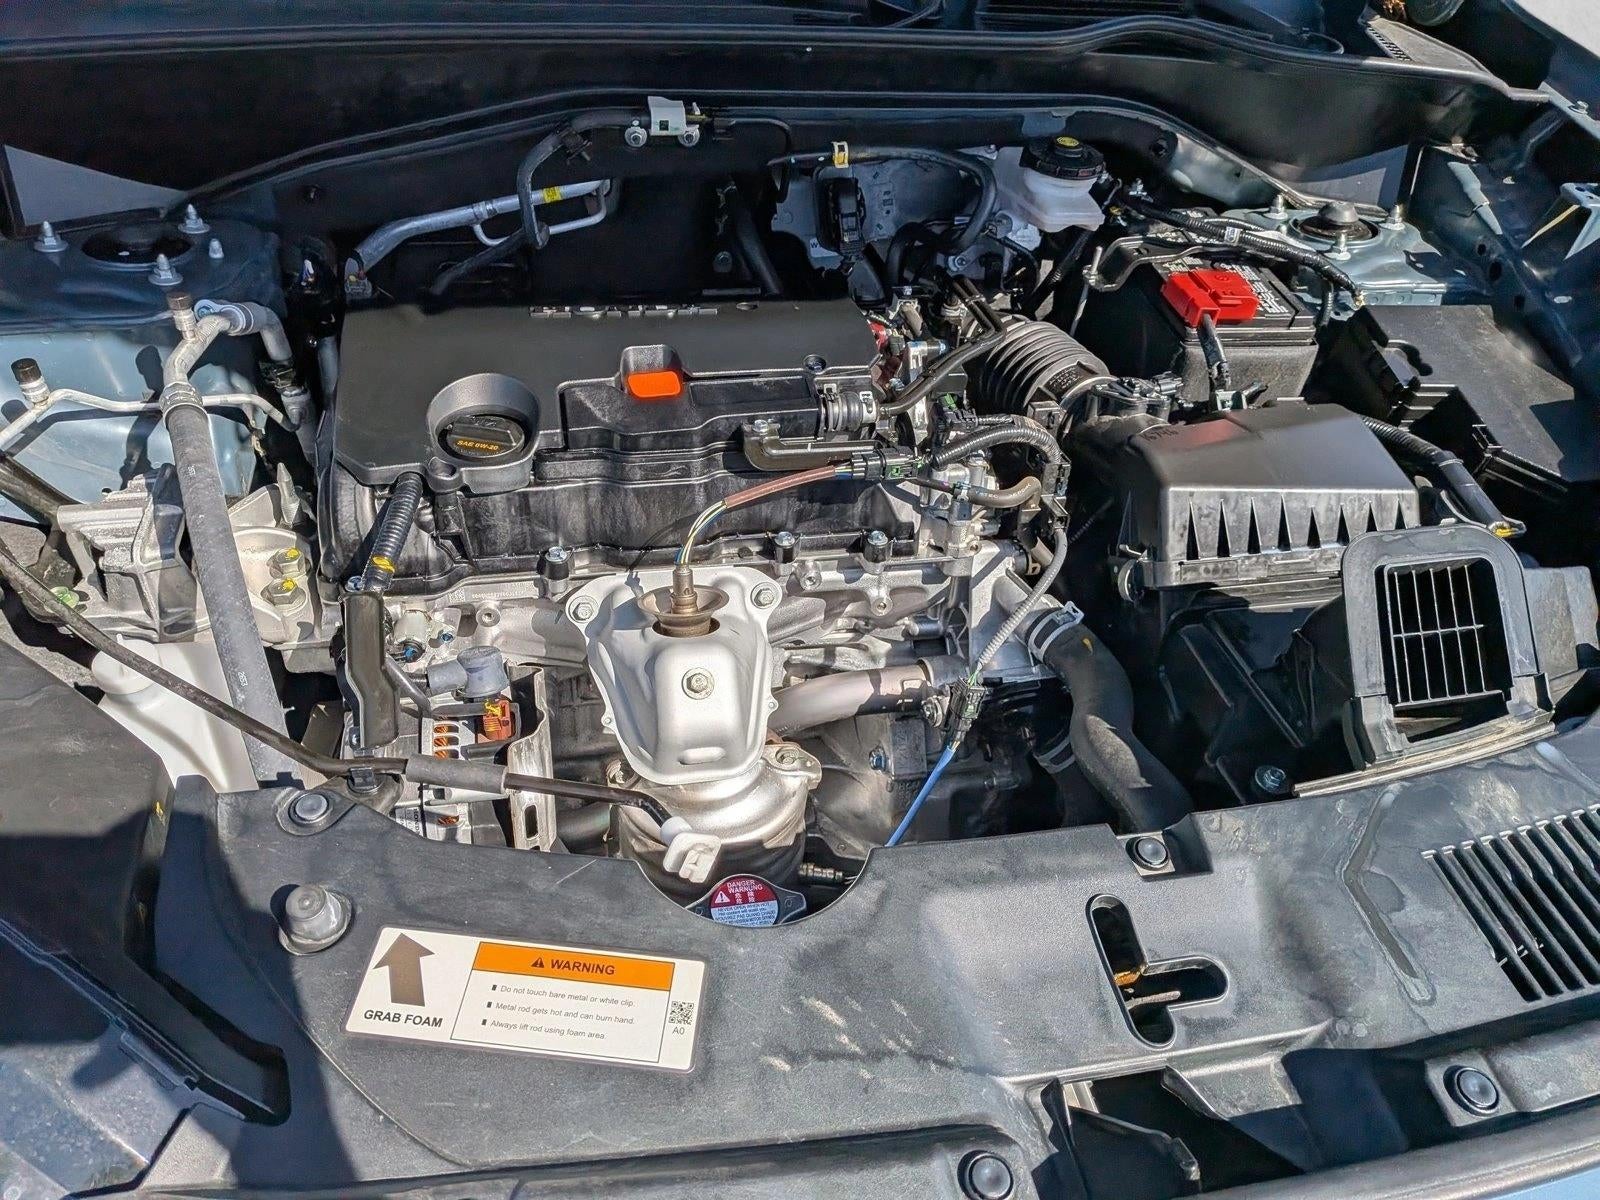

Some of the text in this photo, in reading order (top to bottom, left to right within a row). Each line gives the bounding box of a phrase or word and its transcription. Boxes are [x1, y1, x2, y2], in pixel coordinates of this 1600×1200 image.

[727, 880, 755, 888] DANGER
[551, 958, 615, 975] WARNING
[500, 985, 512, 993] Do
[526, 988, 547, 997] touch
[567, 993, 589, 1002] metal
[600, 997, 619, 1005] white
[620, 1000, 636, 1008] clip.
[364, 1009, 443, 1028] GRAB FOAM
[495, 1002, 517, 1012] Metal
[518, 1005, 531, 1013] rod
[532, 1007, 548, 1016] gets
[550, 1008, 562, 1016] hot
[614, 1016, 635, 1024] hand.
[490, 1020, 518, 1030] Always
[519, 1023, 529, 1031] lift
[530, 1024, 543, 1032] rod
[544, 1027, 565, 1036] using
[566, 1028, 586, 1037] foam
[672, 1026, 685, 1035] A0
